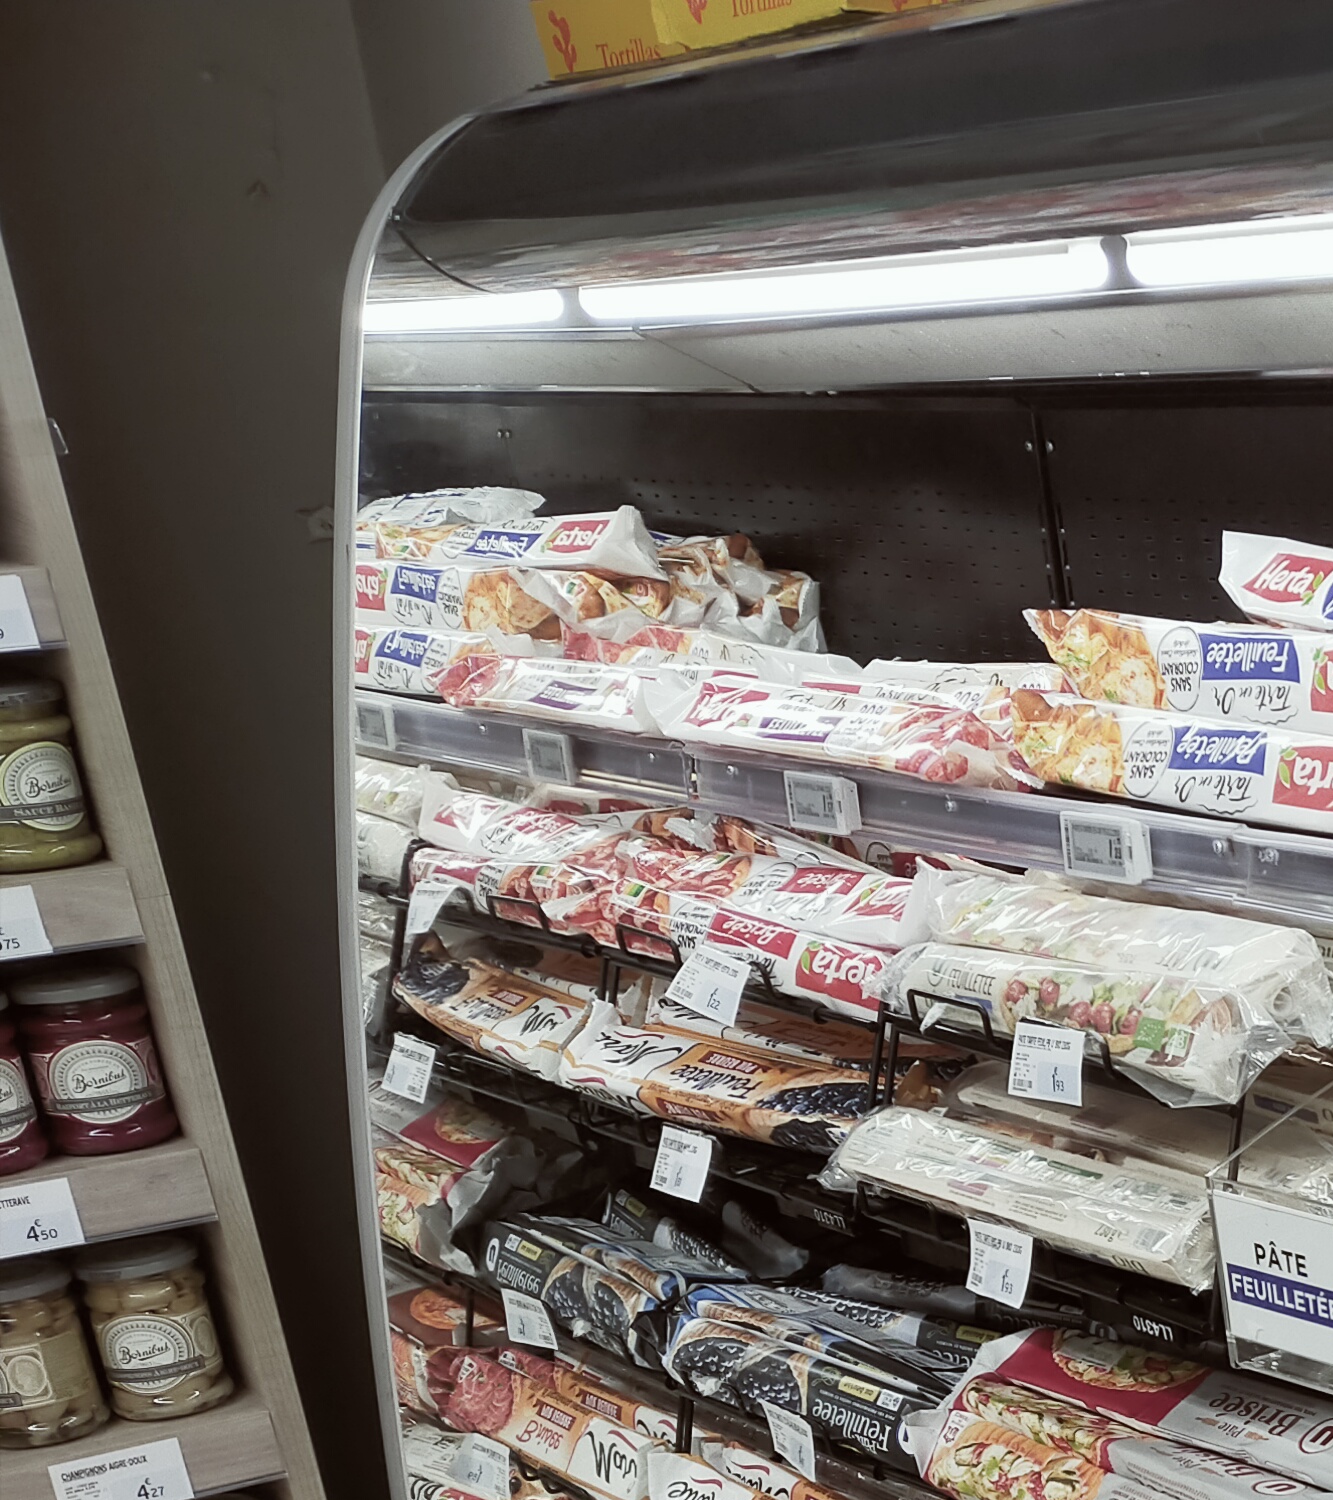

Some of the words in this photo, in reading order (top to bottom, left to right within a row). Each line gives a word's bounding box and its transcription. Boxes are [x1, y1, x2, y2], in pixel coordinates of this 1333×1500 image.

[1257, 560, 1312, 597] Herta
[1205, 635, 1290, 669] Feuilletée
[1159, 661, 1200, 678] COLORANT
[1171, 678, 1195, 694] SANS
[1135, 763, 1156, 780] SANS
[71, 1067, 126, 1095] Bornibus
[1254, 1240, 1308, 1278] PÂTE
[119, 1341, 171, 1364] Bornibus
[1208, 1391, 1305, 1435] Brisée
